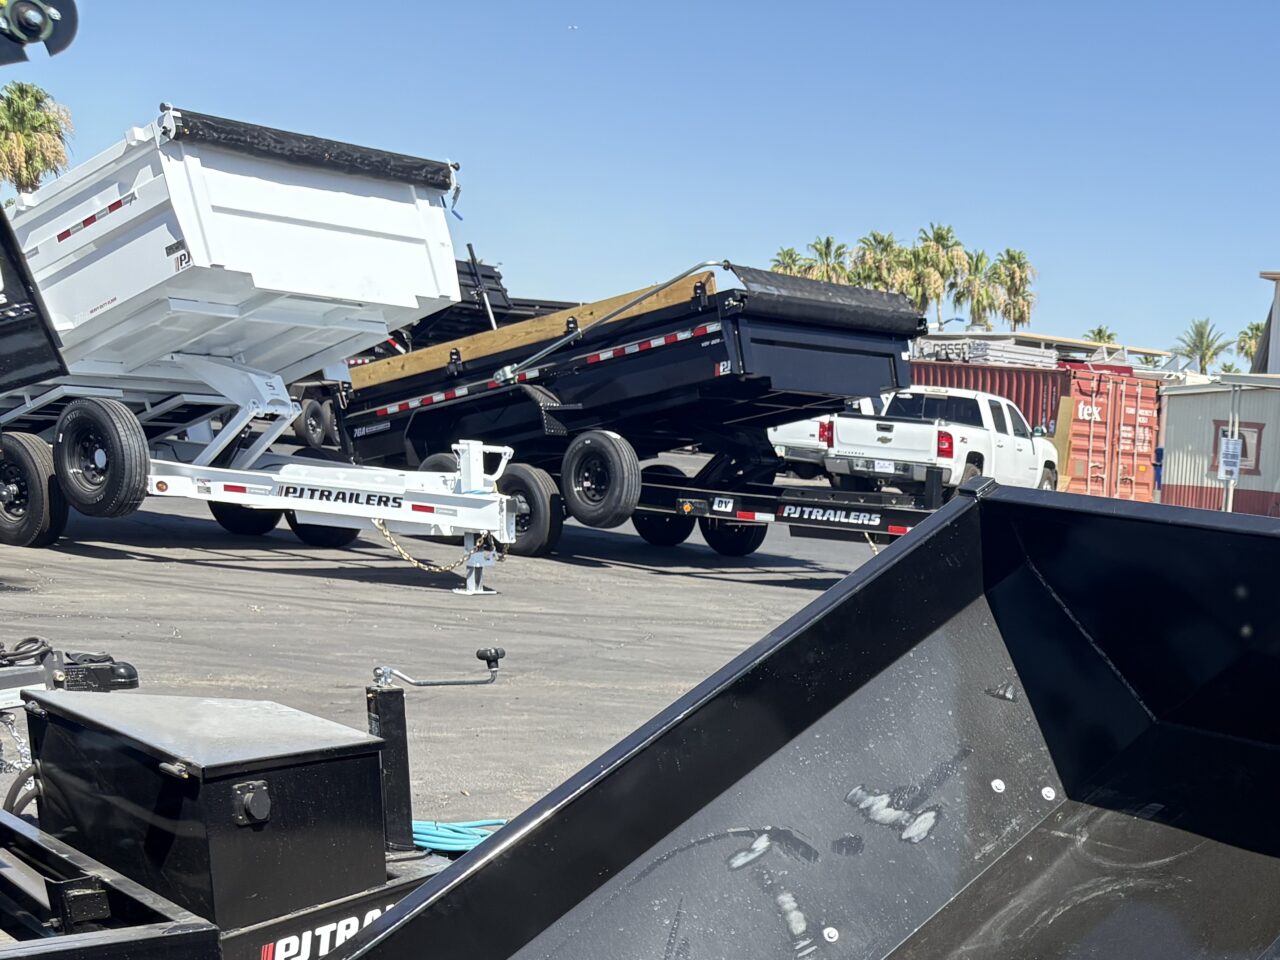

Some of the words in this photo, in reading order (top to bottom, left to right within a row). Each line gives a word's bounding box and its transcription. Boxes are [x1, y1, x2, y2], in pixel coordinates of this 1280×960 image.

[1077, 401, 1102, 422] tex
[307, 488, 404, 508] TRAILERS
[783, 505, 804, 518] PJ
[803, 506, 882, 526] TRAILERS
